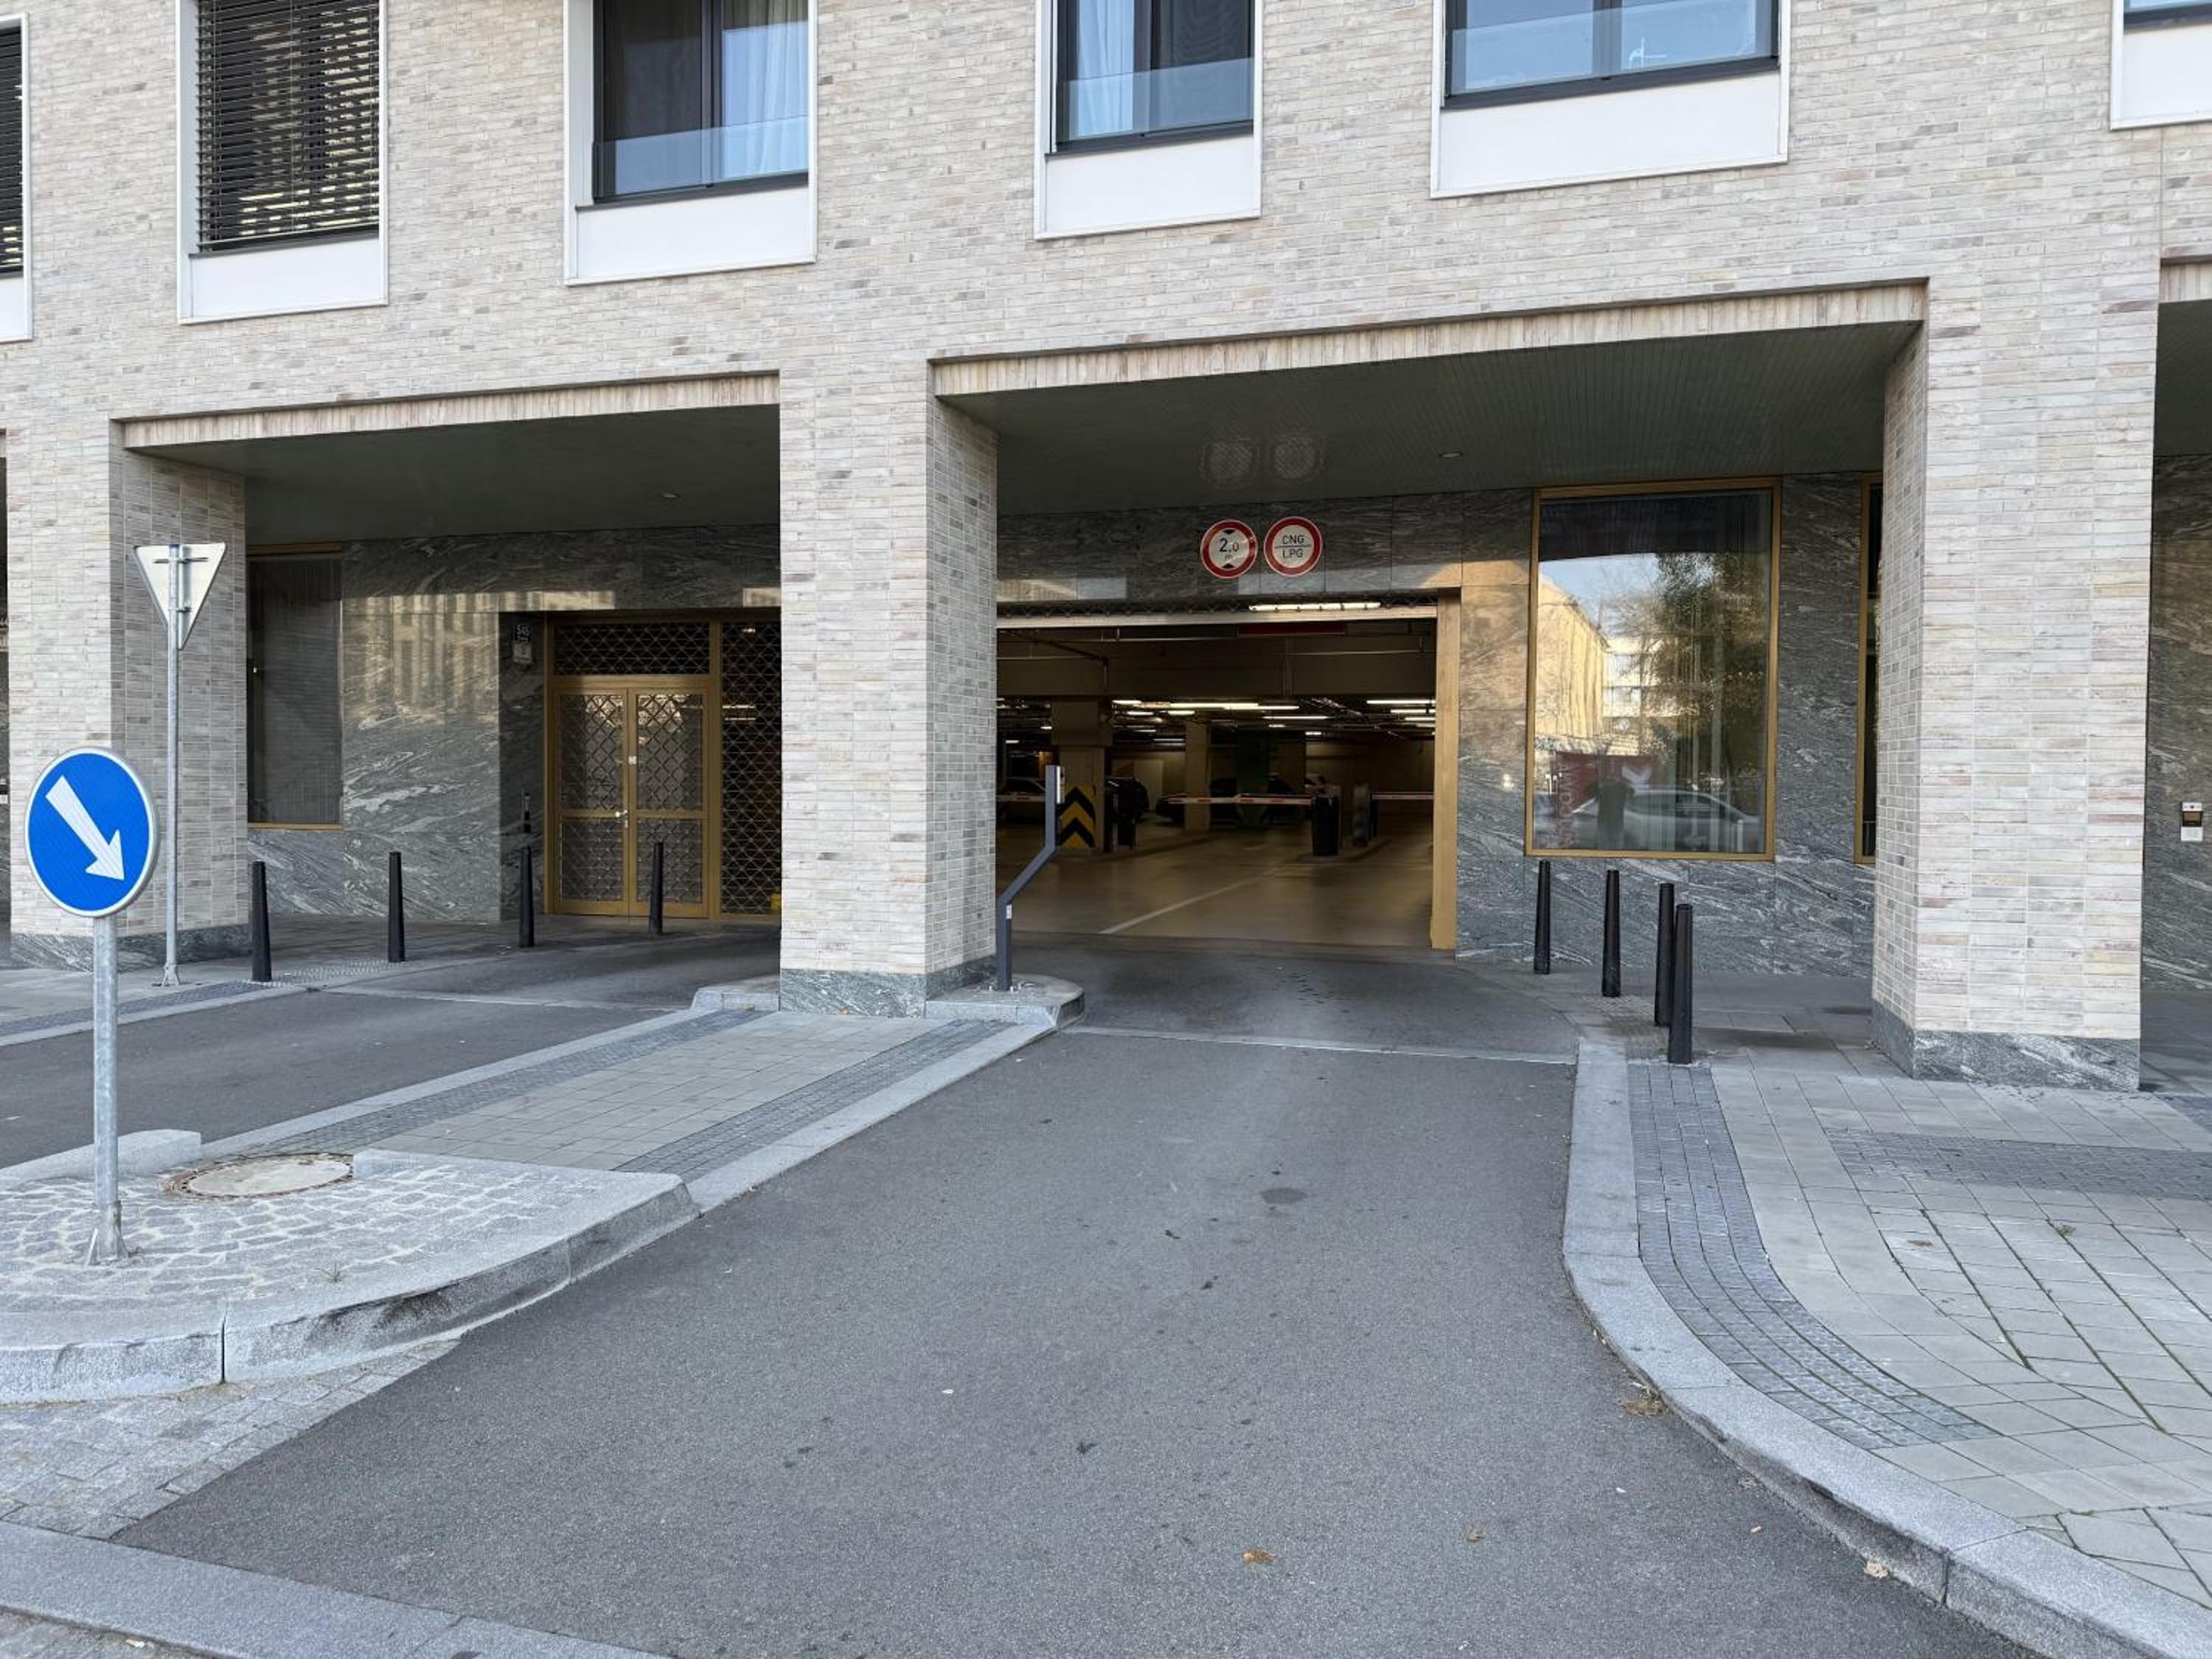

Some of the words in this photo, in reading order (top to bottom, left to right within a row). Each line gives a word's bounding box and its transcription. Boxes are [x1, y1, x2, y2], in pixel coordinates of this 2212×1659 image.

[1282, 535, 1304, 544] CNG
[1219, 538, 1239, 552] 2.0
[1282, 548, 1304, 558] LPG
